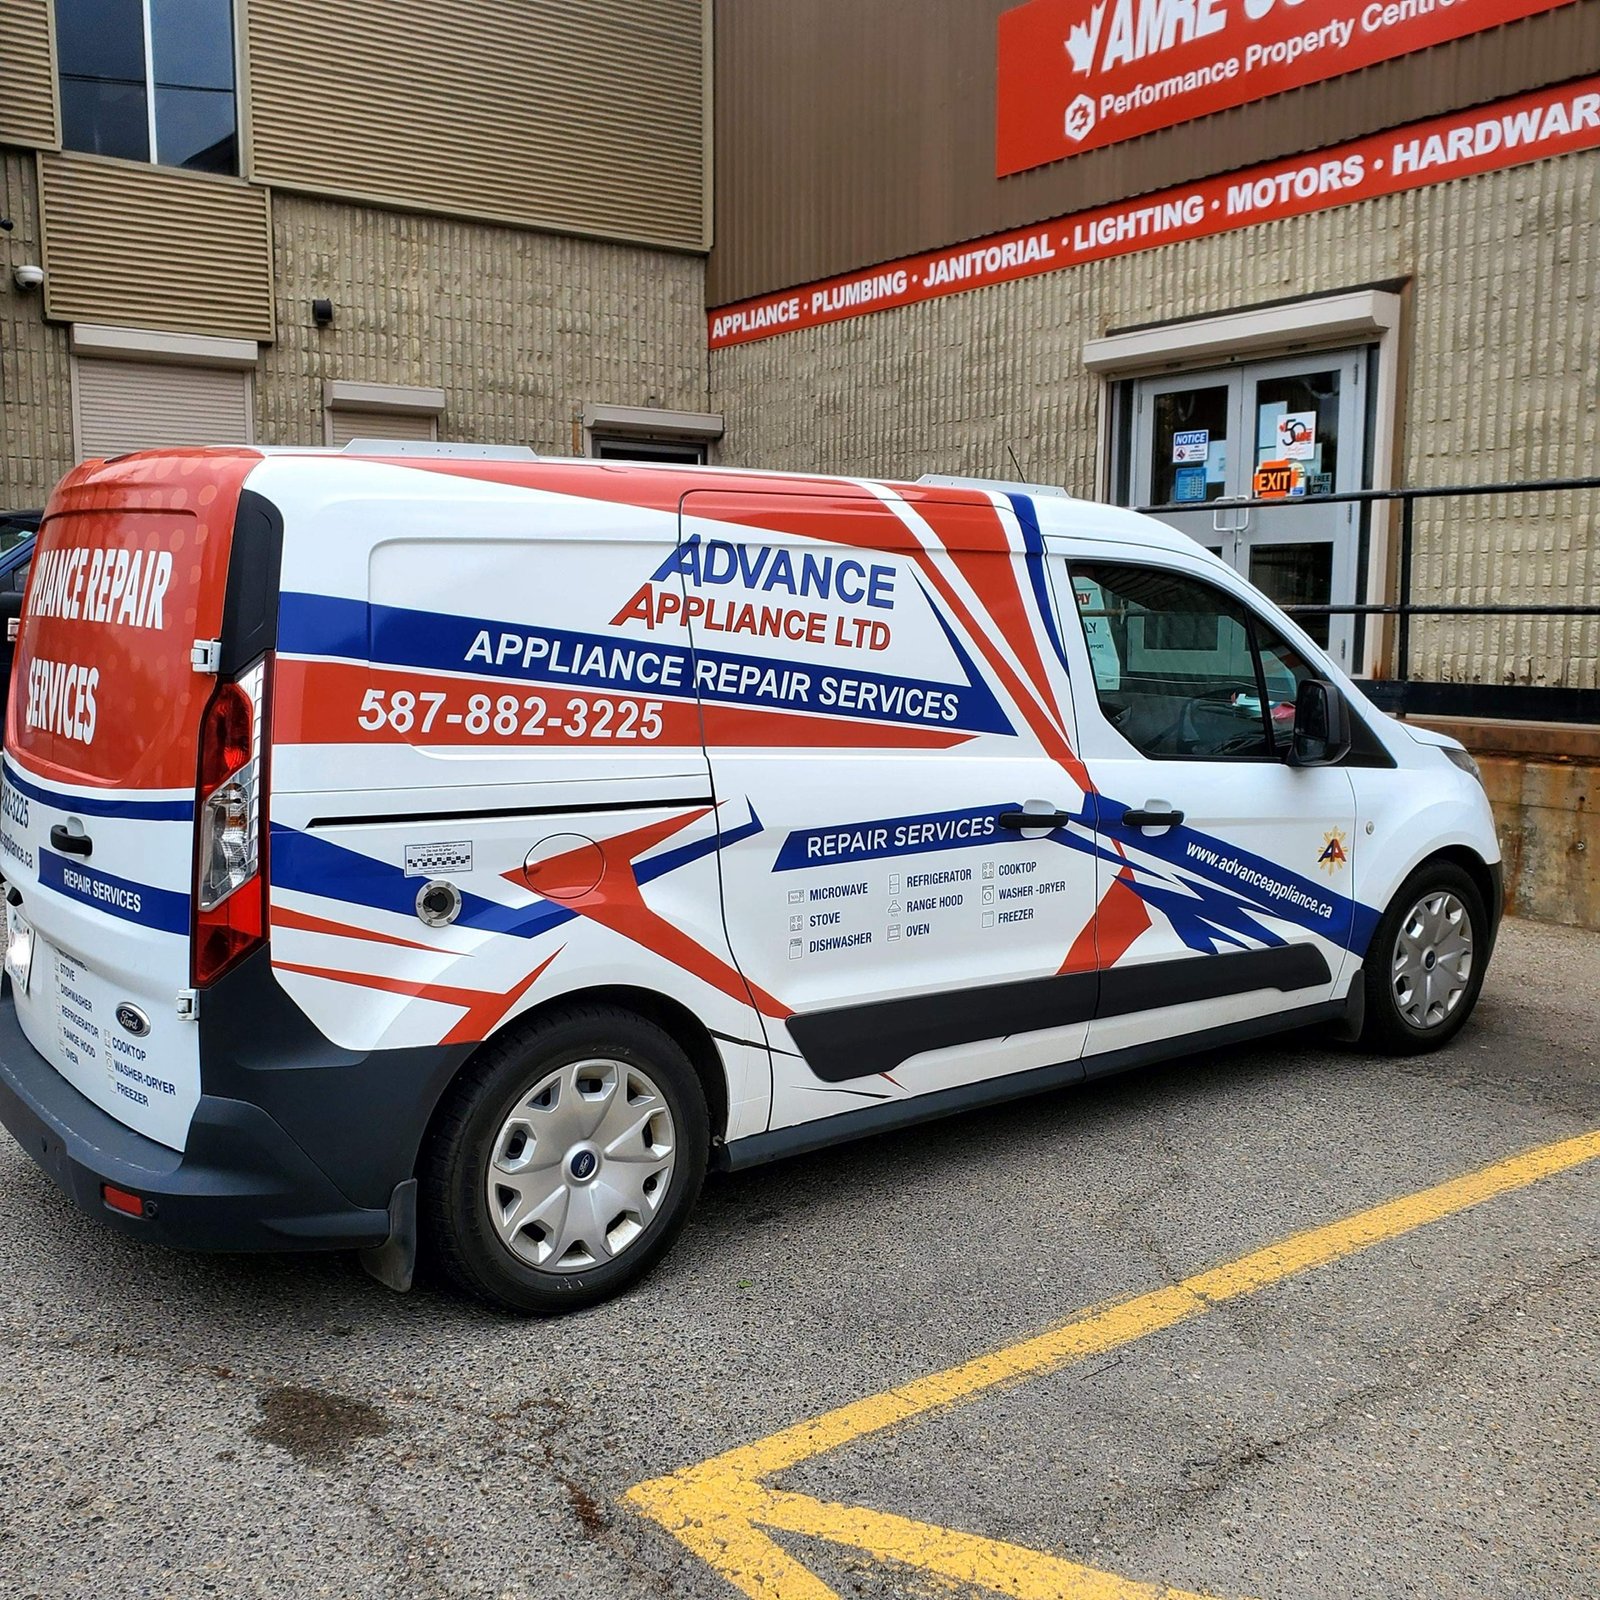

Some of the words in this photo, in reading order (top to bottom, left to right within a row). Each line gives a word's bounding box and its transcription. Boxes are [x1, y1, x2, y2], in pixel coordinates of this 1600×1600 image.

[1099, 57, 1240, 119] Performance
[1245, 18, 1354, 72] Property
[712, 298, 800, 339] APPLIANCE
[812, 271, 907, 315] PLUMBING
[923, 234, 1055, 287] JANITORIAL
[1074, 195, 1204, 251] LIGHTING
[1227, 155, 1365, 214] MOTORS
[1176, 433, 1206, 445] NOTICE
[1258, 471, 1290, 491] EXIT
[650, 533, 896, 609] ADVANCE
[82, 548, 172, 630] REPAIR
[609, 583, 827, 643] APPLIANCE
[835, 616, 891, 651] LTD
[464, 630, 685, 687] APPLIANCE
[692, 658, 811, 702] REPAIR
[819, 677, 959, 722] SERVICES
[26, 657, 100, 745] SERVICES
[358, 688, 663, 739] 587-882-3225
[807, 829, 887, 858] REPAIR
[894, 816, 995, 846] SERVICES
[906, 869, 972, 888] REFRIGERATOR
[999, 862, 1037, 876] COOKTOP
[1186, 842, 1333, 919] www.advanceappliance.ca
[63, 868, 92, 897] REPAIR
[93, 877, 142, 913] SERVICES
[809, 883, 868, 902] MICROWAVE
[906, 897, 937, 913] RANGE
[939, 894, 963, 909] HOOD
[809, 912, 840, 928] STOVE
[998, 909, 1034, 924] FREEZER
[809, 932, 872, 953] DISHWASHER
[906, 924, 930, 937] OVEN
[60, 963, 75, 982] STOVE
[60, 984, 93, 1012] DISHWASHER
[61, 1005, 99, 1039] REFRIGERATOR
[120, 1010, 139, 1031] Ford
[63, 1027, 80, 1047] RANGE
[80, 1039, 96, 1058] HOOD
[112, 1037, 146, 1062] COOKTOP
[65, 1048, 79, 1065] OVEN
[113, 1060, 176, 1096] WASHER-DRYER
[116, 1082, 149, 1107] FREEZER
